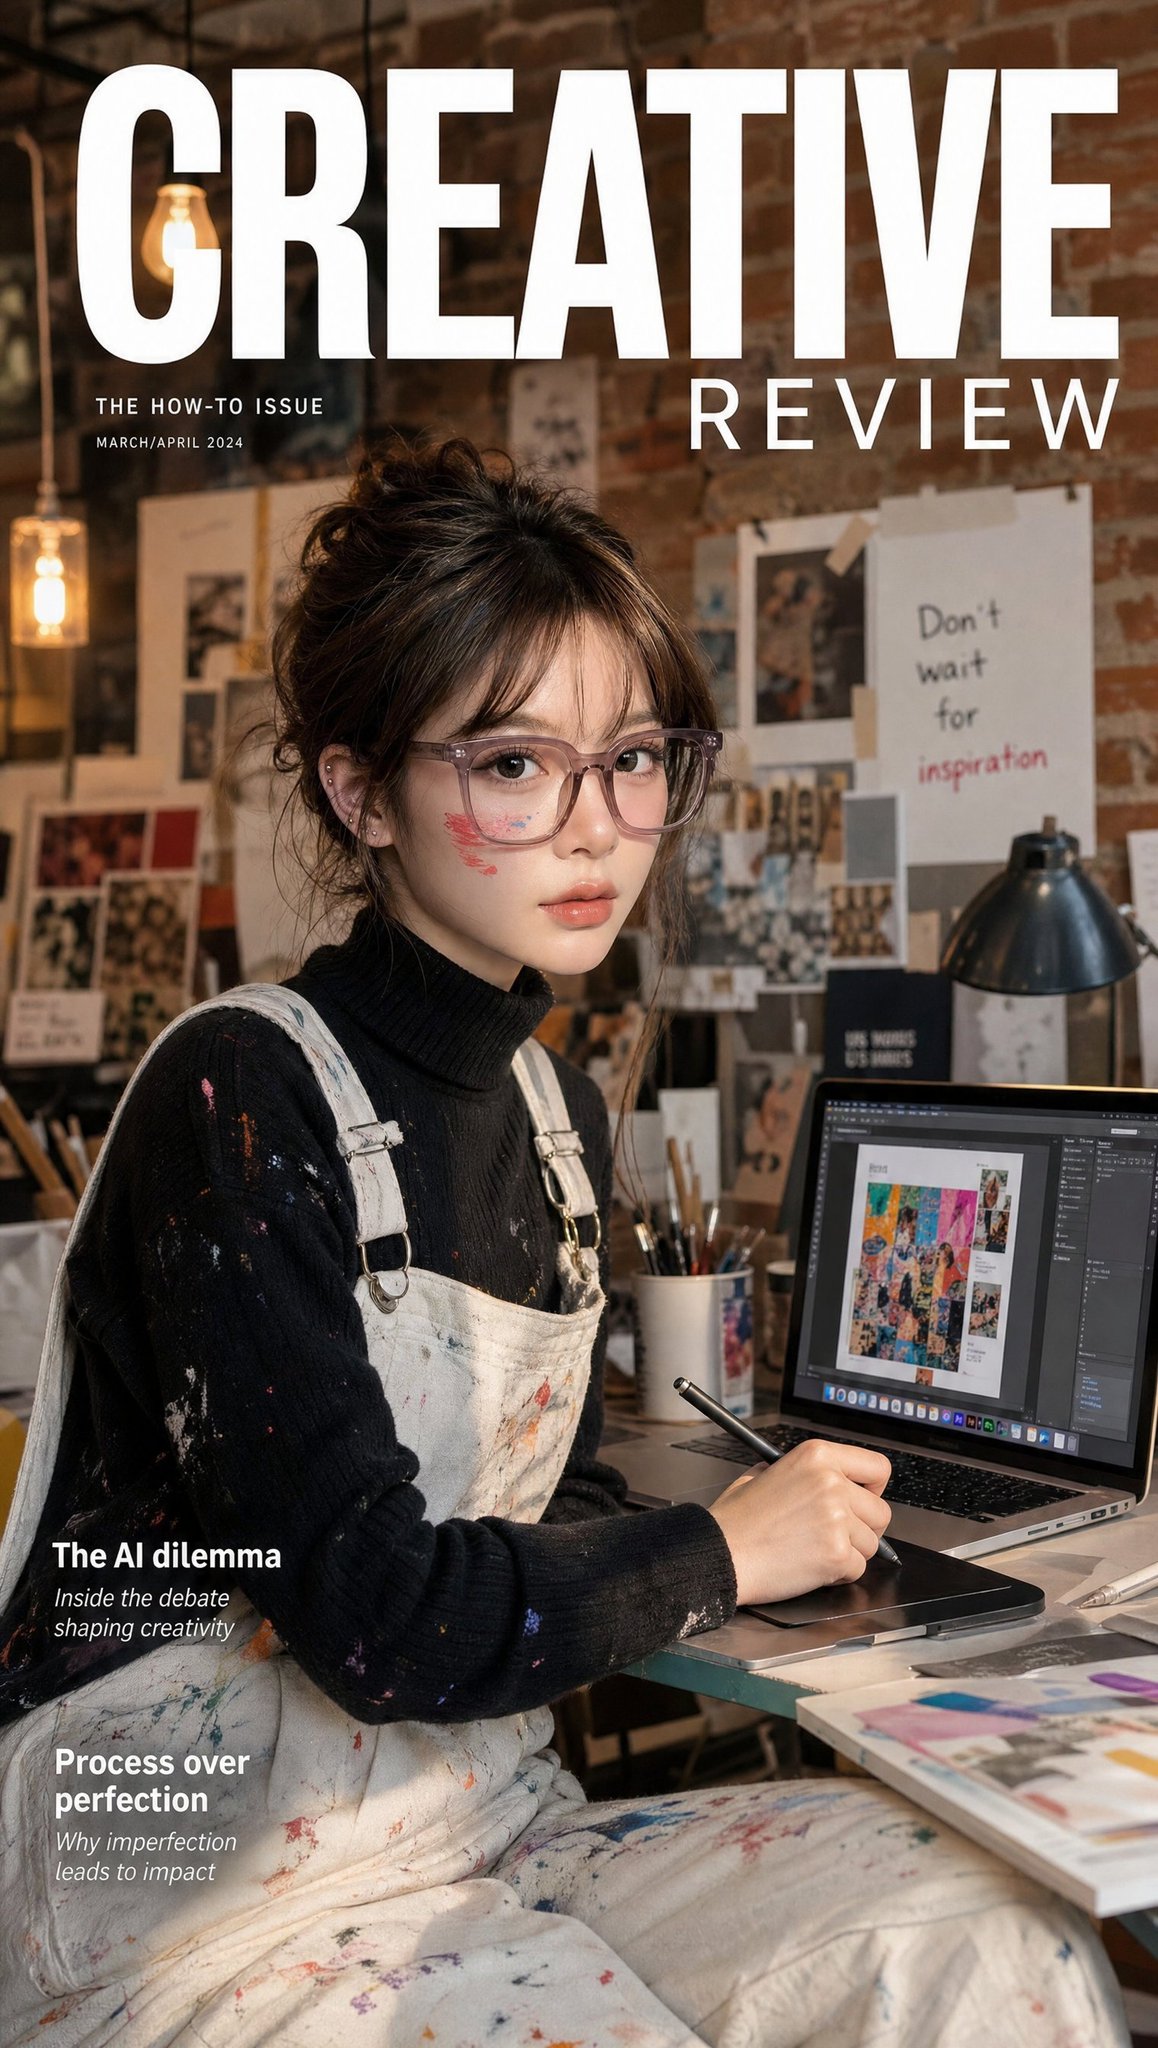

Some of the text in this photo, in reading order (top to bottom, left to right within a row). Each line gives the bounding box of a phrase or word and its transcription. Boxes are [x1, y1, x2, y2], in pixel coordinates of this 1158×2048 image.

[918, 599, 1001, 639] Don't
[916, 648, 988, 684] wait
[934, 696, 979, 731] for
[918, 743, 1048, 792] inspiration
